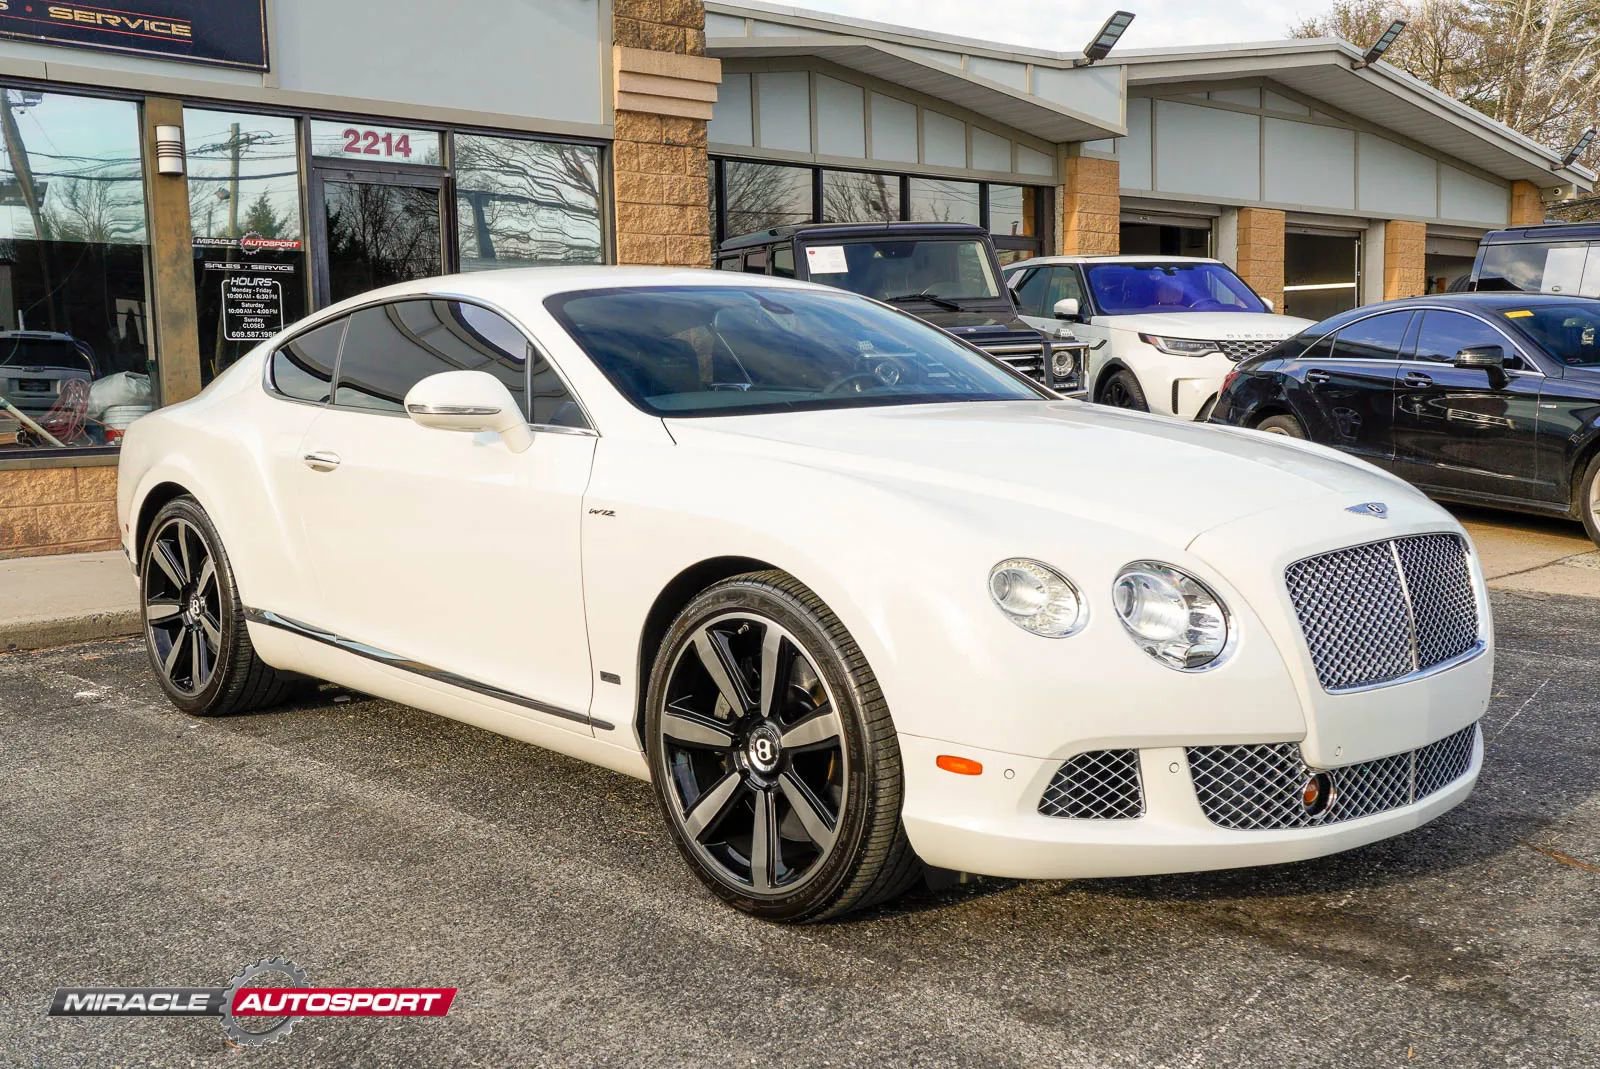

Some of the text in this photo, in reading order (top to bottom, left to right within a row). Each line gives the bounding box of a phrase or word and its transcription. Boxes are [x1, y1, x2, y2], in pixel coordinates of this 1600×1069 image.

[48, 6, 192, 37] SERVICE
[343, 128, 412, 158] 2214
[196, 238, 299, 248] MIRACLE AUTOSPORT
[230, 277, 273, 286] HOURS
[588, 508, 616, 517] W12
